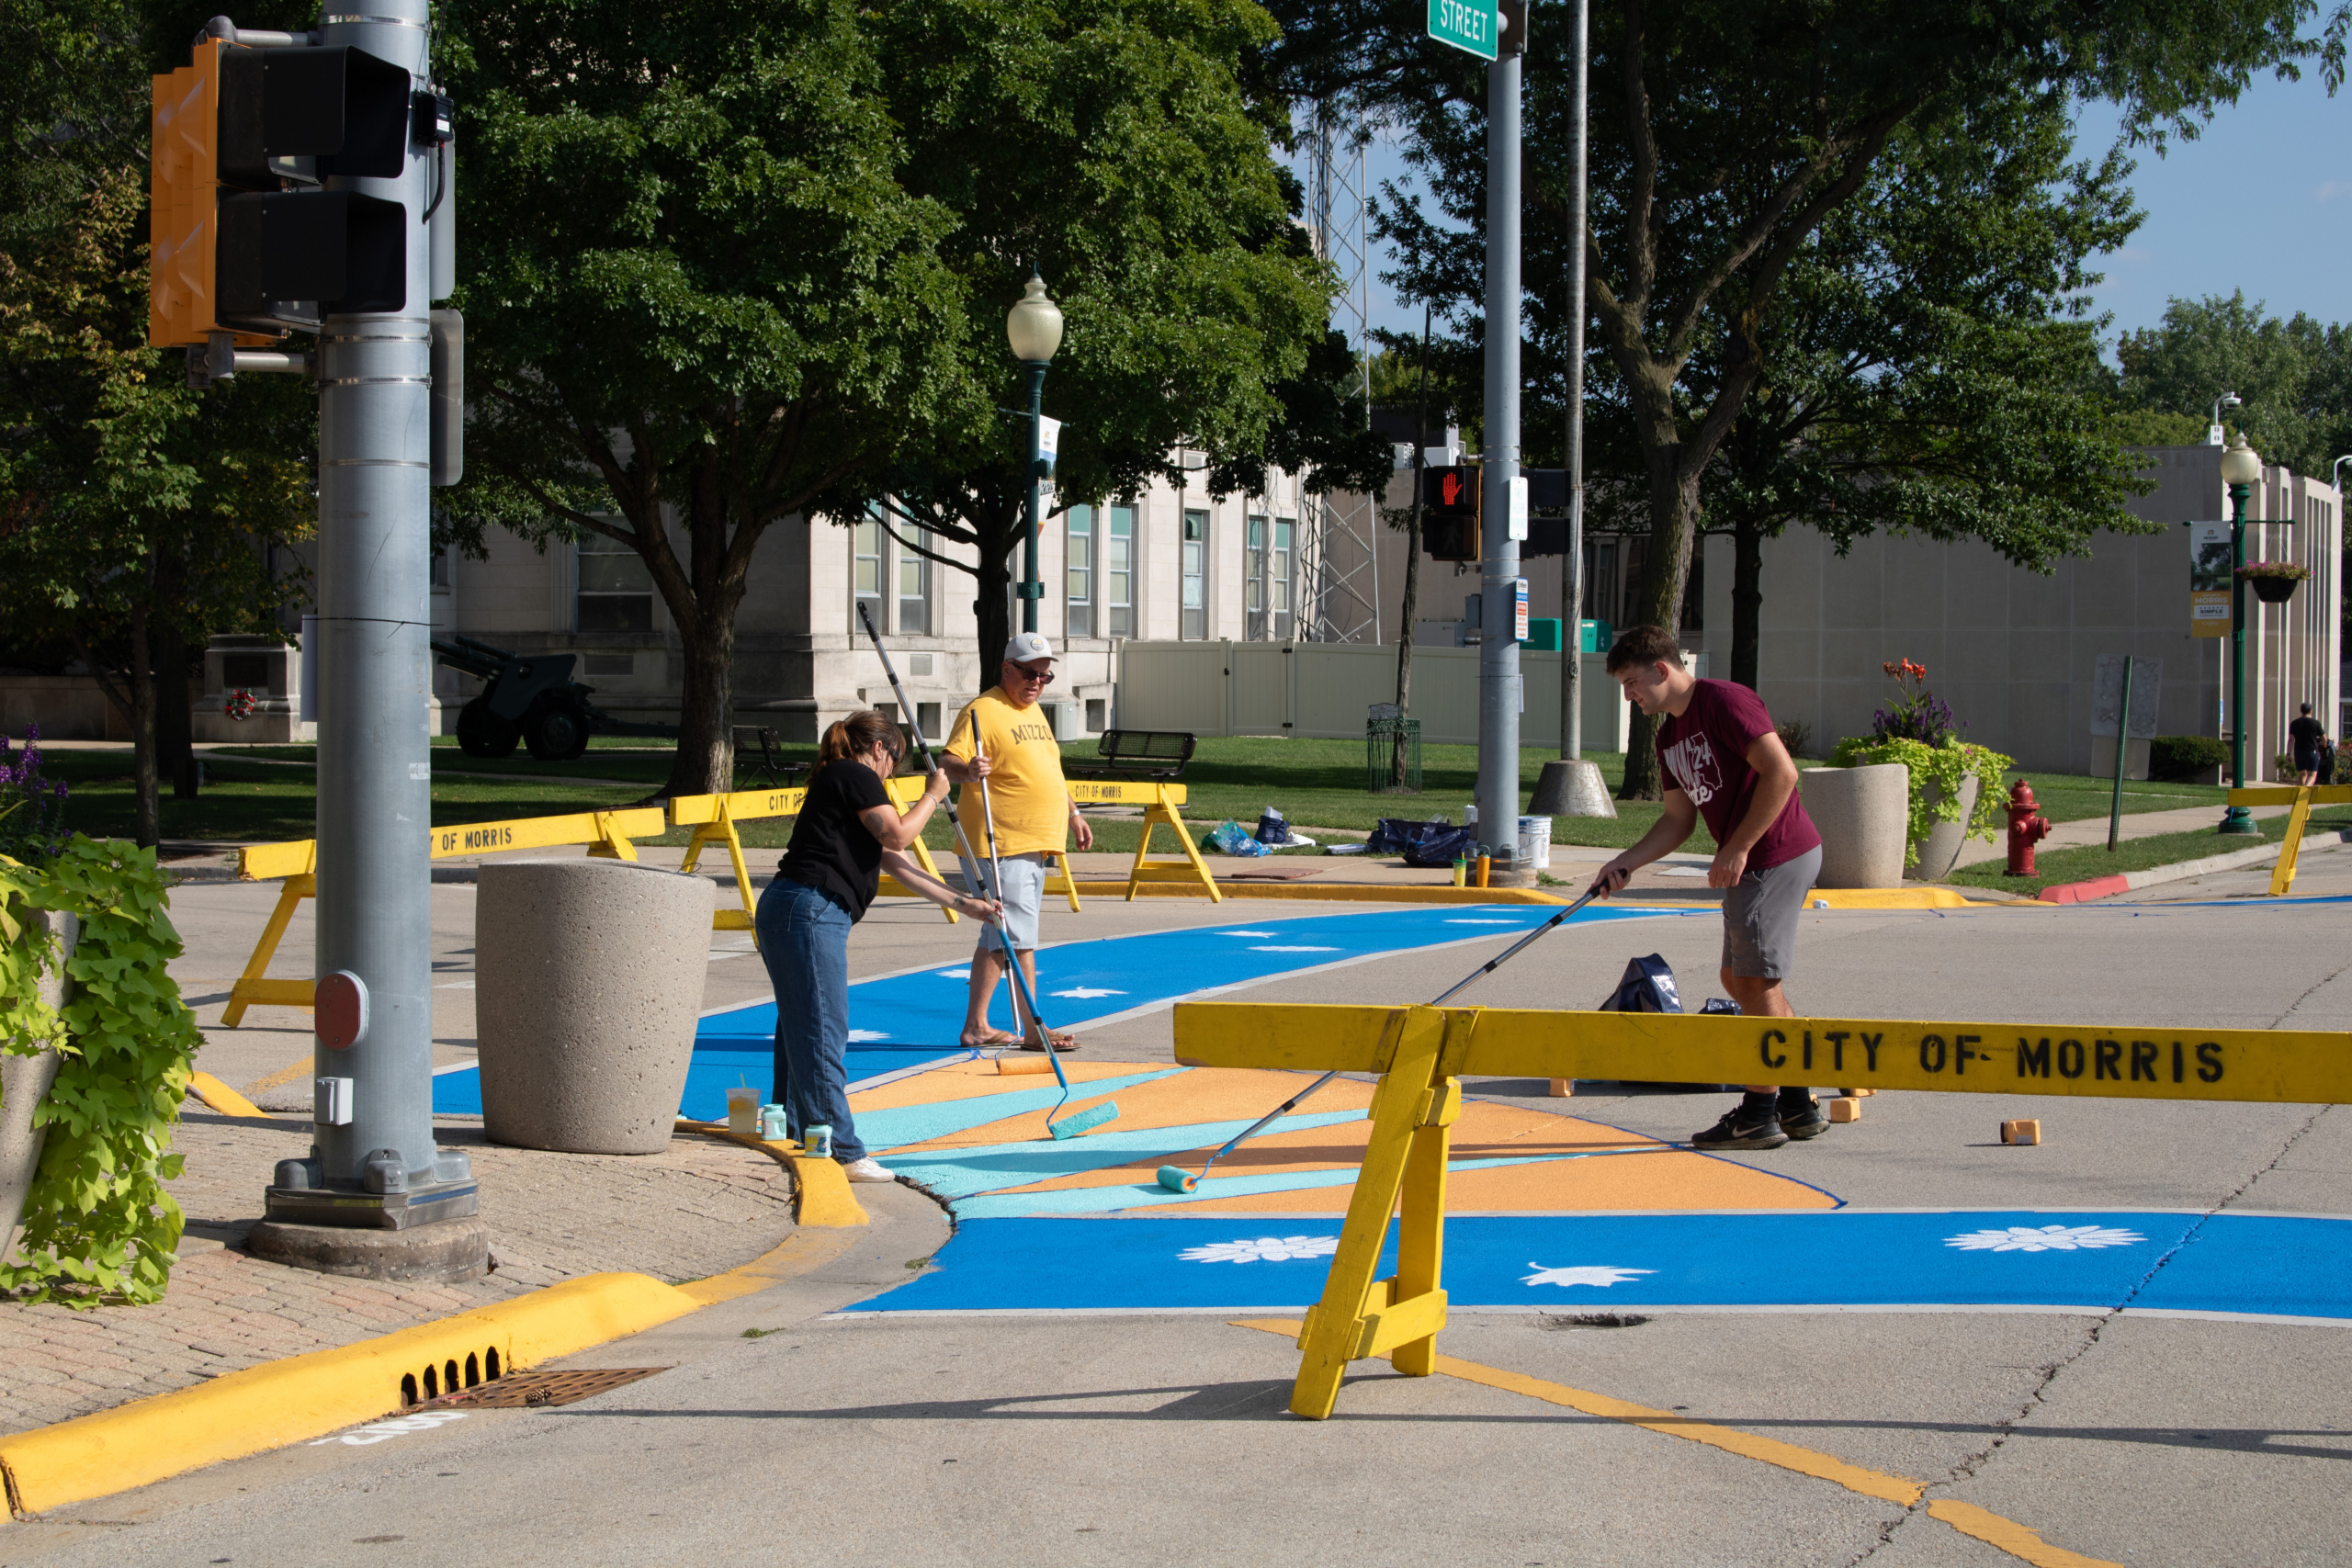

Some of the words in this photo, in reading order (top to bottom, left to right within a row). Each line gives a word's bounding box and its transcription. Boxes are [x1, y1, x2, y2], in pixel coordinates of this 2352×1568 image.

[1440, 0, 1488, 43] STREET
[1512, 502, 1525, 513] HOUR
[1511, 517, 1526, 530] PARKING
[1010, 724, 1055, 745] MIZZO
[1693, 740, 1712, 771] 24
[1075, 784, 1090, 798] CITY
[1091, 784, 1099, 798] OF
[1101, 785, 1122, 799] MORRIS
[769, 794, 789, 811] CITY
[442, 832, 458, 851] OF
[465, 827, 512, 850] MORRIS
[1759, 1029, 1884, 1073] CITY
[1918, 1033, 1982, 1076] OF
[2017, 1037, 2224, 1084] MORRIS
